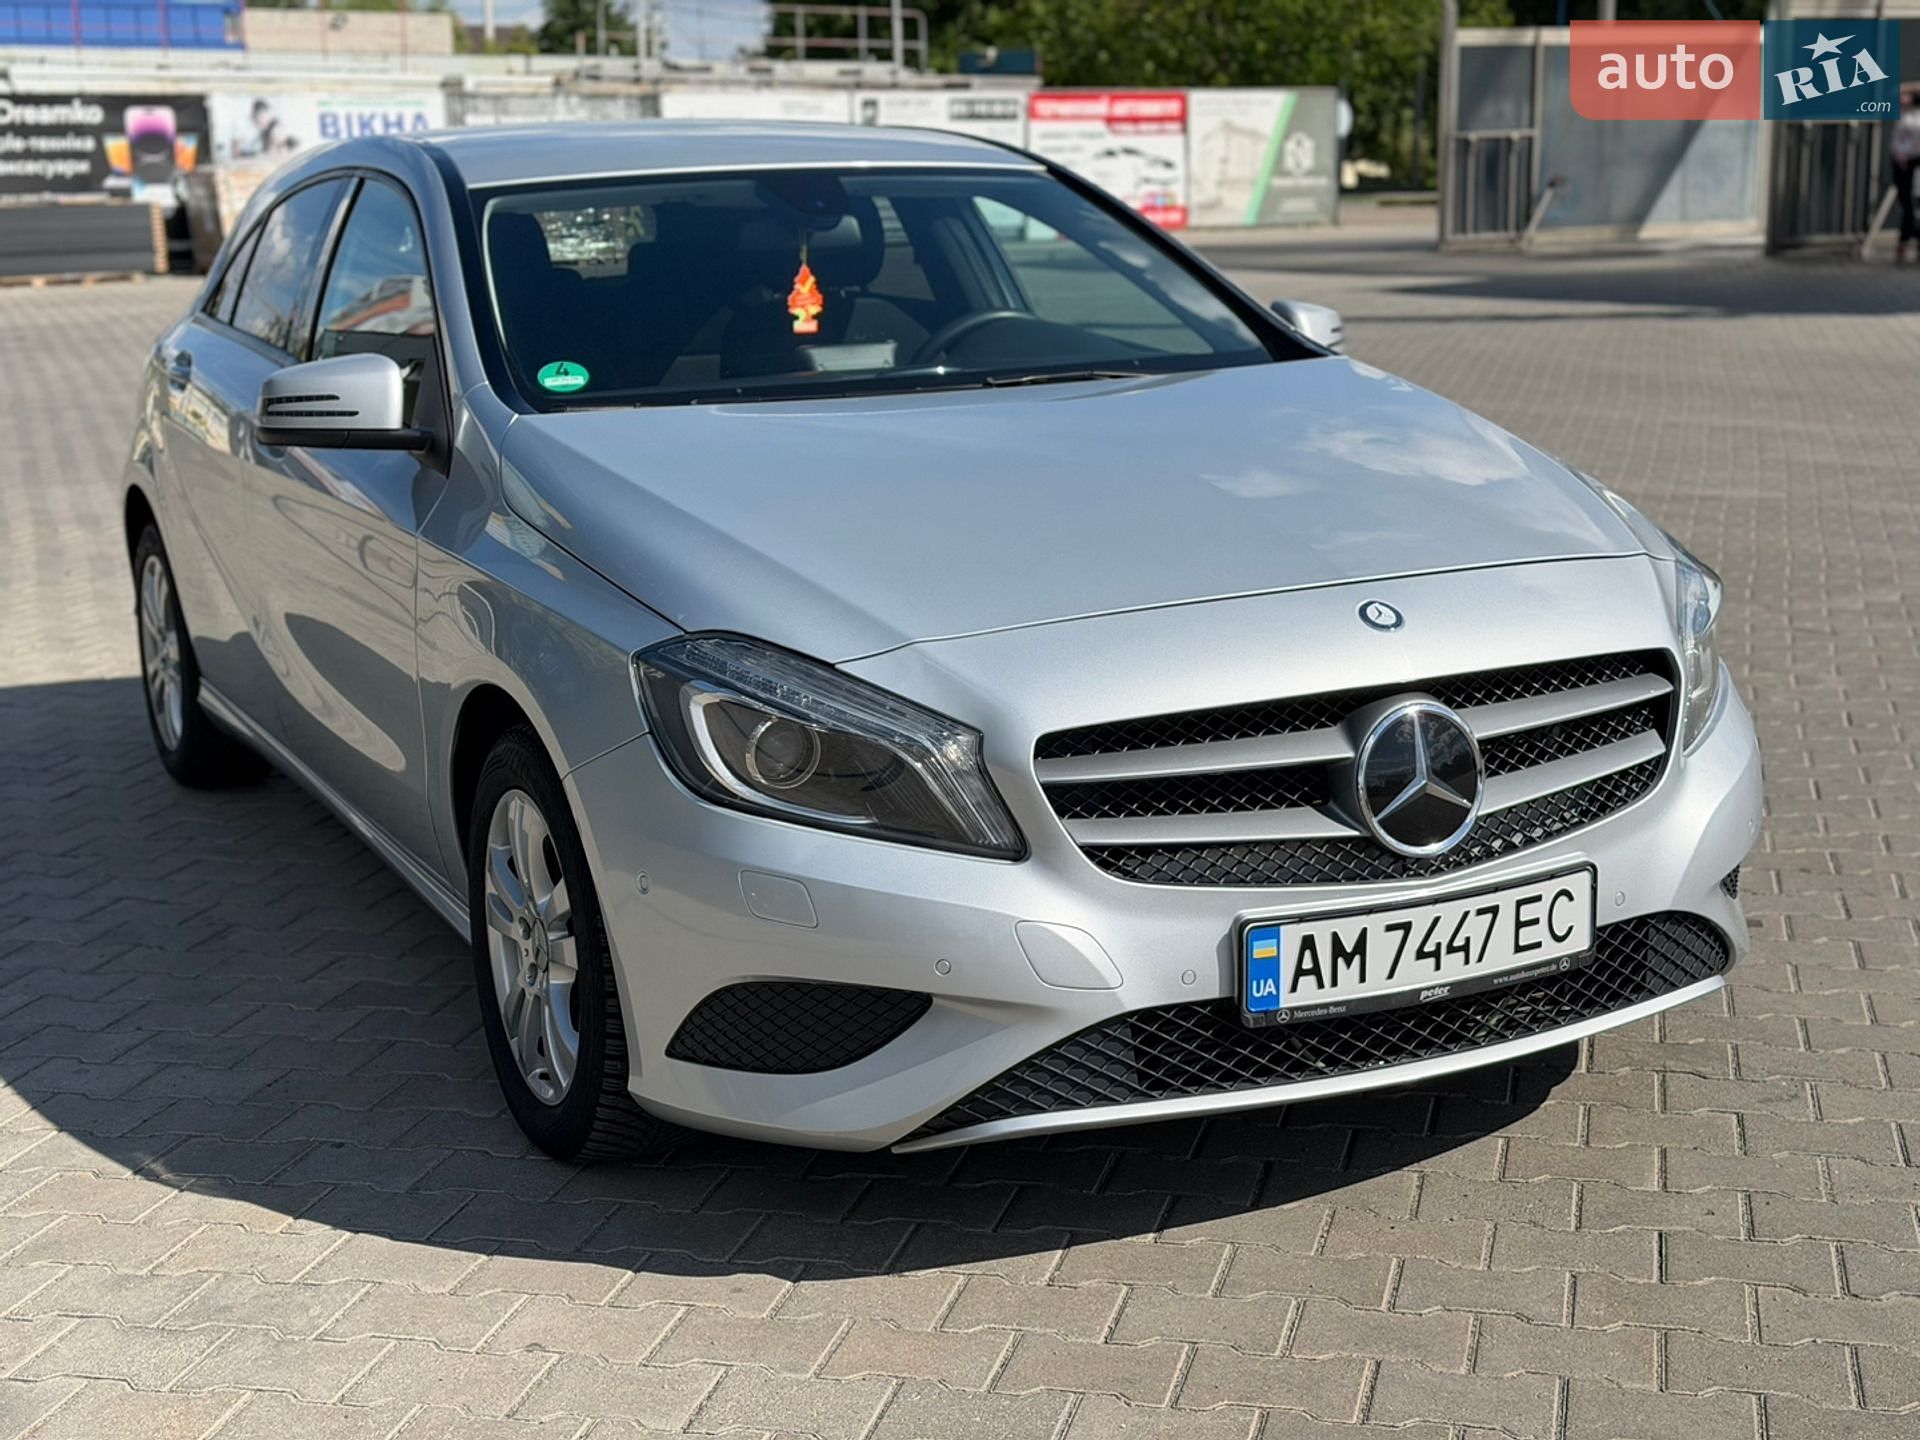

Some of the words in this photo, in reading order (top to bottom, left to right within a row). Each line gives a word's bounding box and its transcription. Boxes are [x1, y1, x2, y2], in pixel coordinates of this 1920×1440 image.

[555, 362, 570, 377] 4
[1289, 927, 1367, 993] AM
[1385, 904, 1500, 979] 7447
[1513, 888, 1575, 953] EC
[1252, 977, 1277, 998] UA
[1419, 986, 1450, 1001] peter
[1293, 1005, 1347, 1019] Mercedes-Benz
